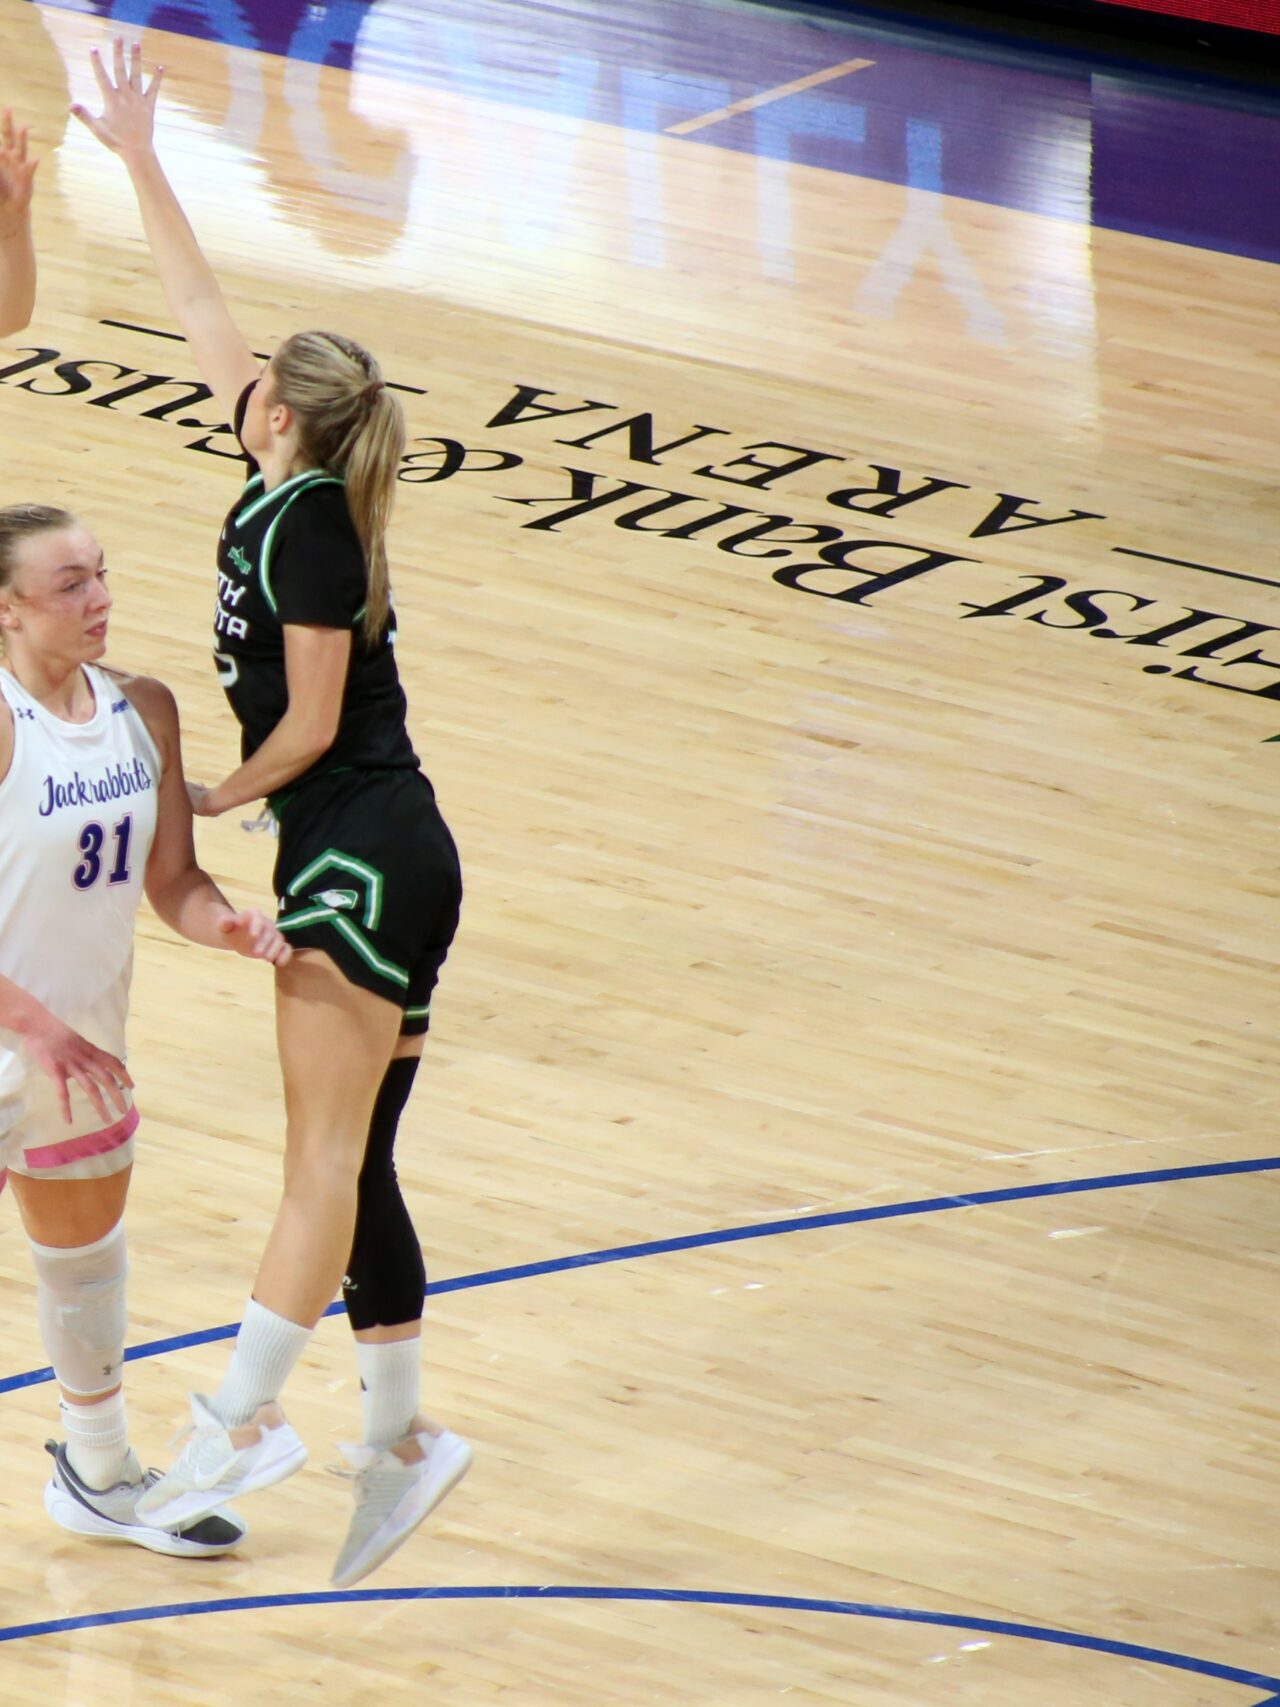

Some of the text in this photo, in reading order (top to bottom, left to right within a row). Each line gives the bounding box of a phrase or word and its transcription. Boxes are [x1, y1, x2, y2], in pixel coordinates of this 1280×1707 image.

[485, 384, 1108, 539] ARENA
[493, 466, 984, 608] Bank
[39, 758, 151, 816] Jackrabbits
[72, 811, 134, 891] 31
